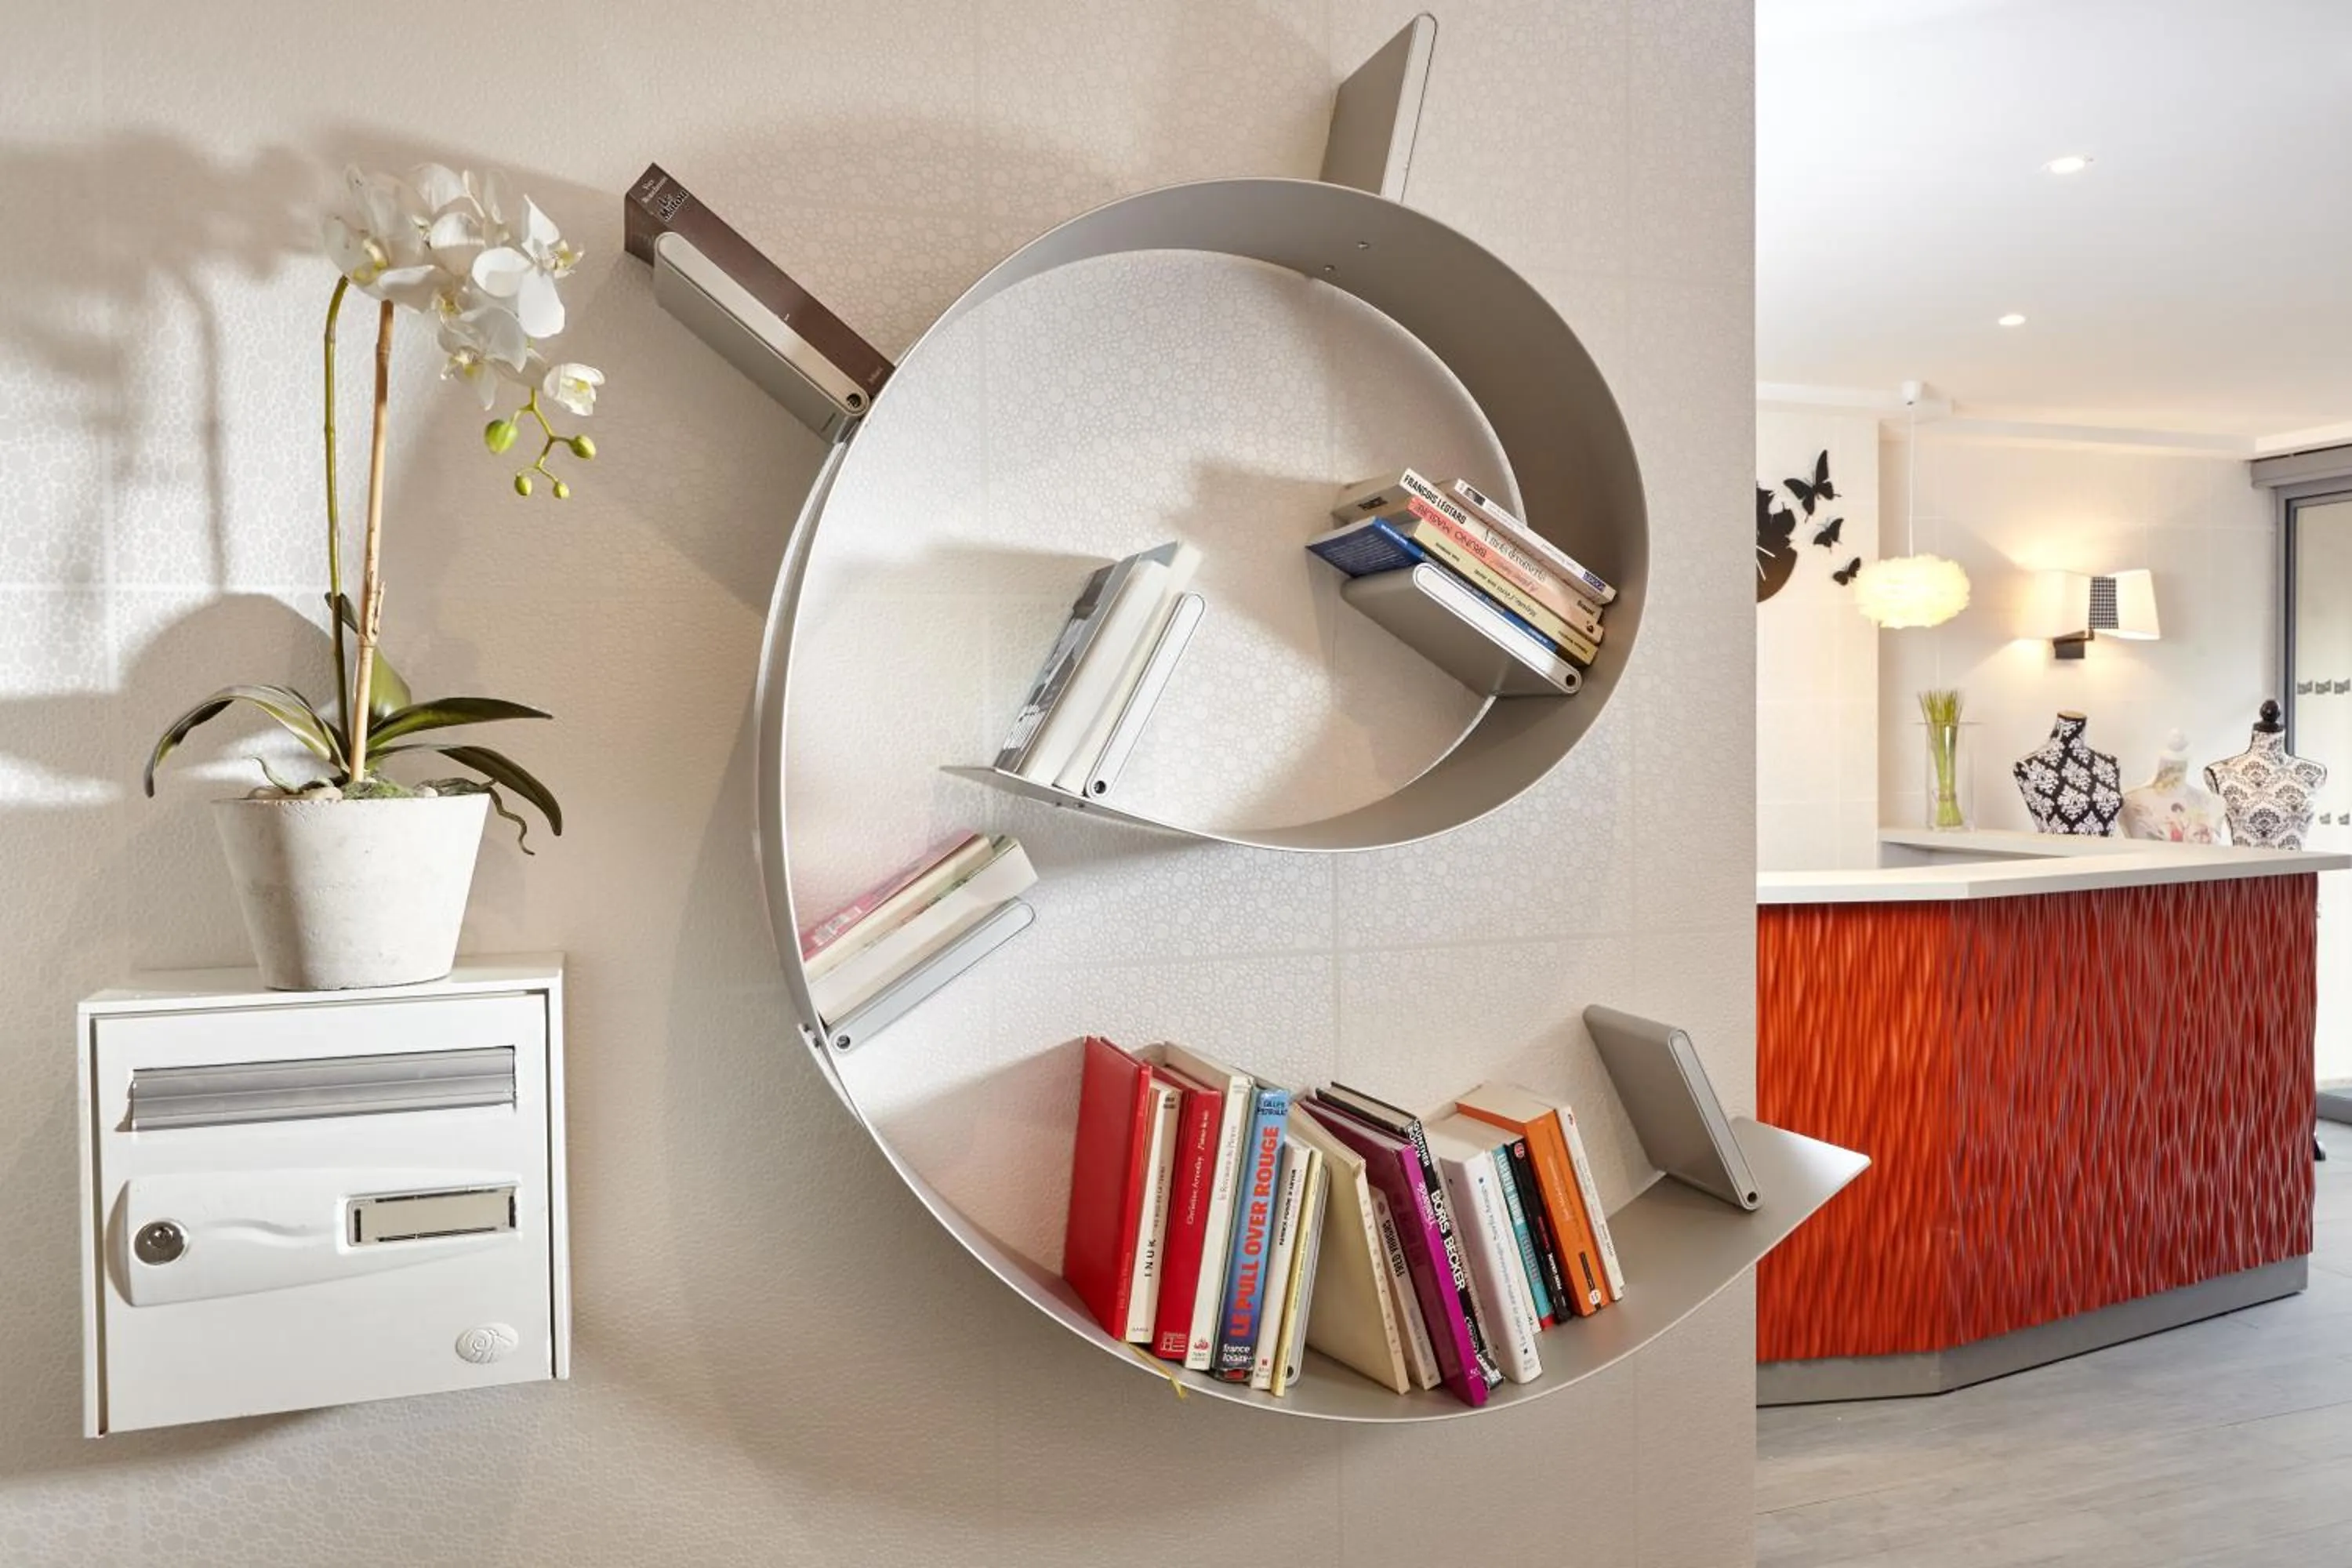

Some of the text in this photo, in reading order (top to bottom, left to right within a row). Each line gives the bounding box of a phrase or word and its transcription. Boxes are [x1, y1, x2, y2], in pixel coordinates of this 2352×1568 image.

[1229, 1126, 1279, 1337] LE PULL OVER ROUGE
[1431, 1189, 1466, 1292] BORIS BECKER
[1222, 1343, 1251, 1354] france
